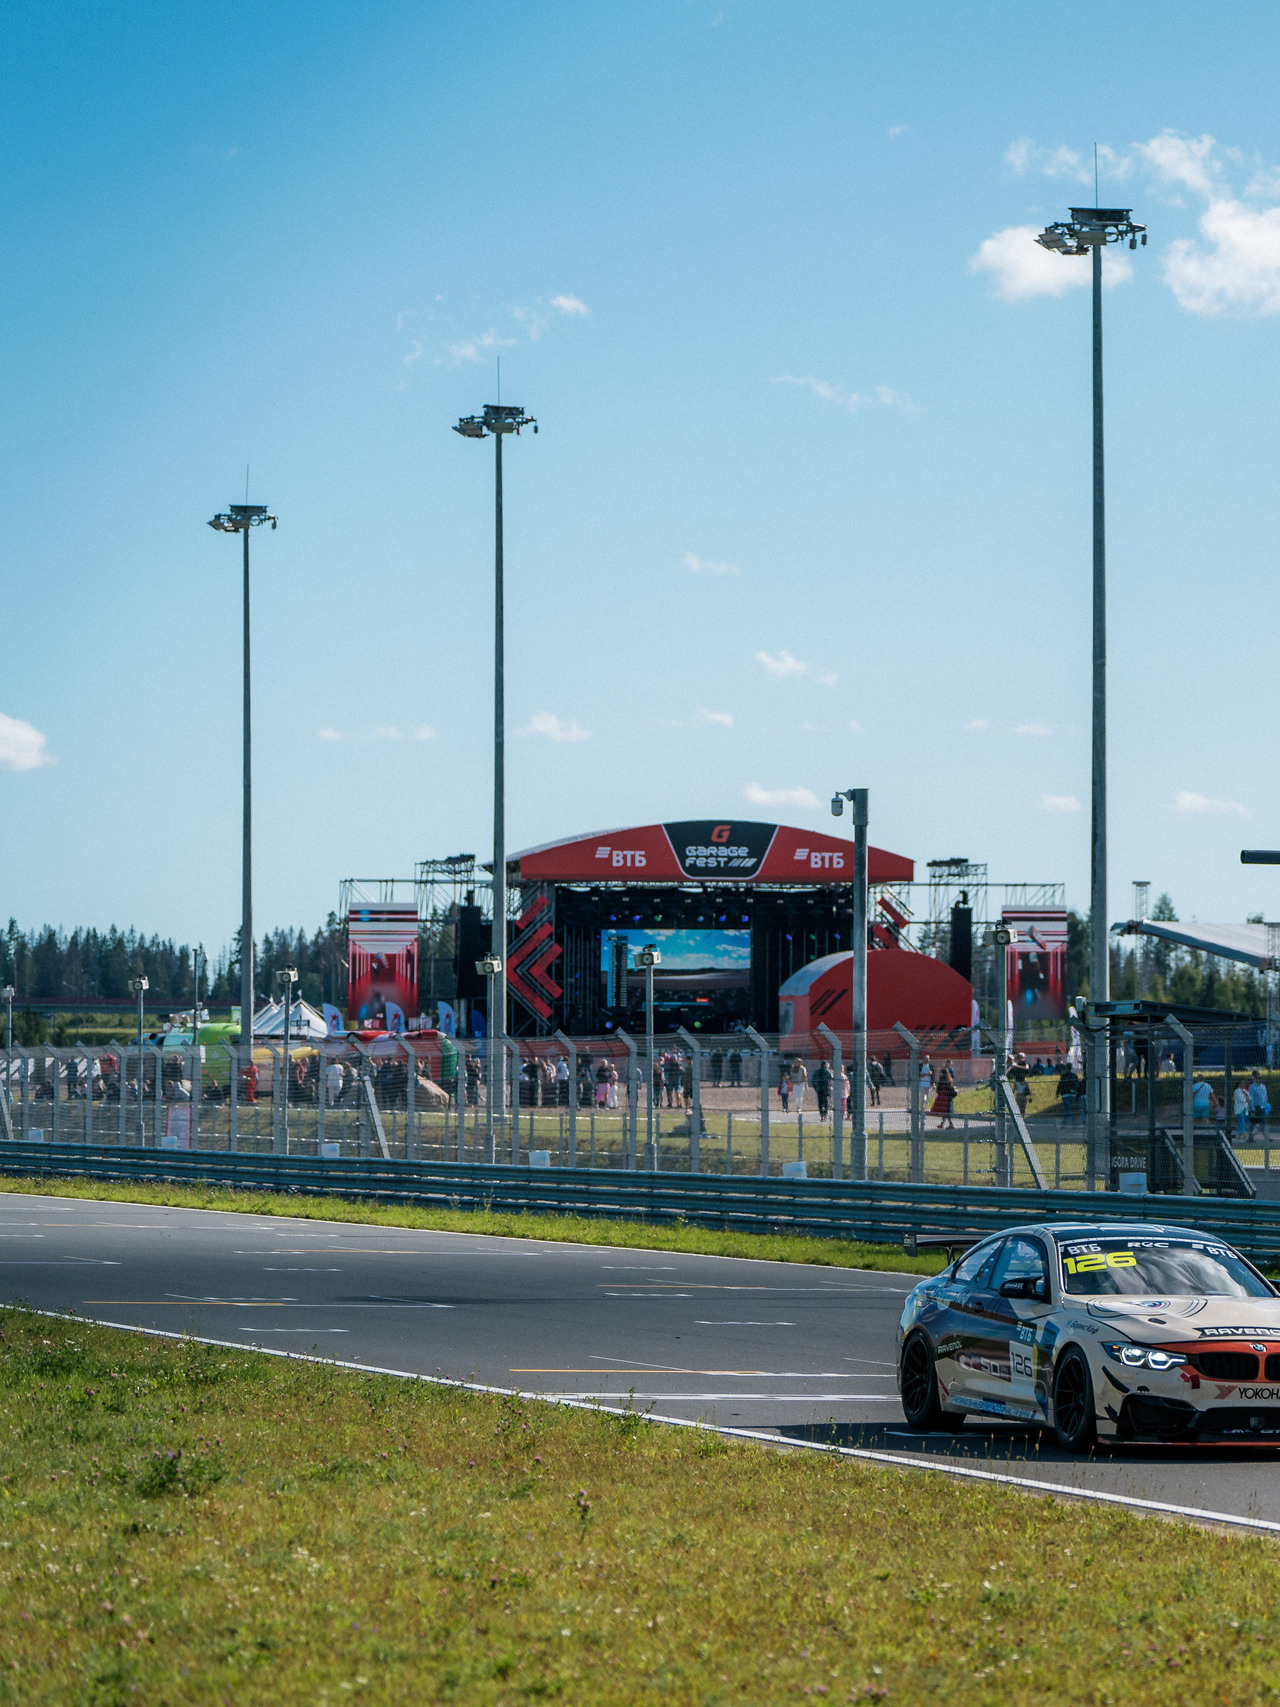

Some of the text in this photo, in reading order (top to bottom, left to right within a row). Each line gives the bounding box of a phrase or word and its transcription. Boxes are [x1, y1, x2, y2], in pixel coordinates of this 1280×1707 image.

[612, 851, 647, 867] ВТБ
[810, 852, 844, 868] ВТБ
[1066, 1243, 1102, 1255] ВТБ
[1206, 1246, 1239, 1259] ВТБ
[1063, 1251, 1137, 1275] 126
[1019, 1327, 1032, 1342] ВТБ
[937, 1340, 963, 1354] RAVENOL
[1011, 1352, 1033, 1378] 126
